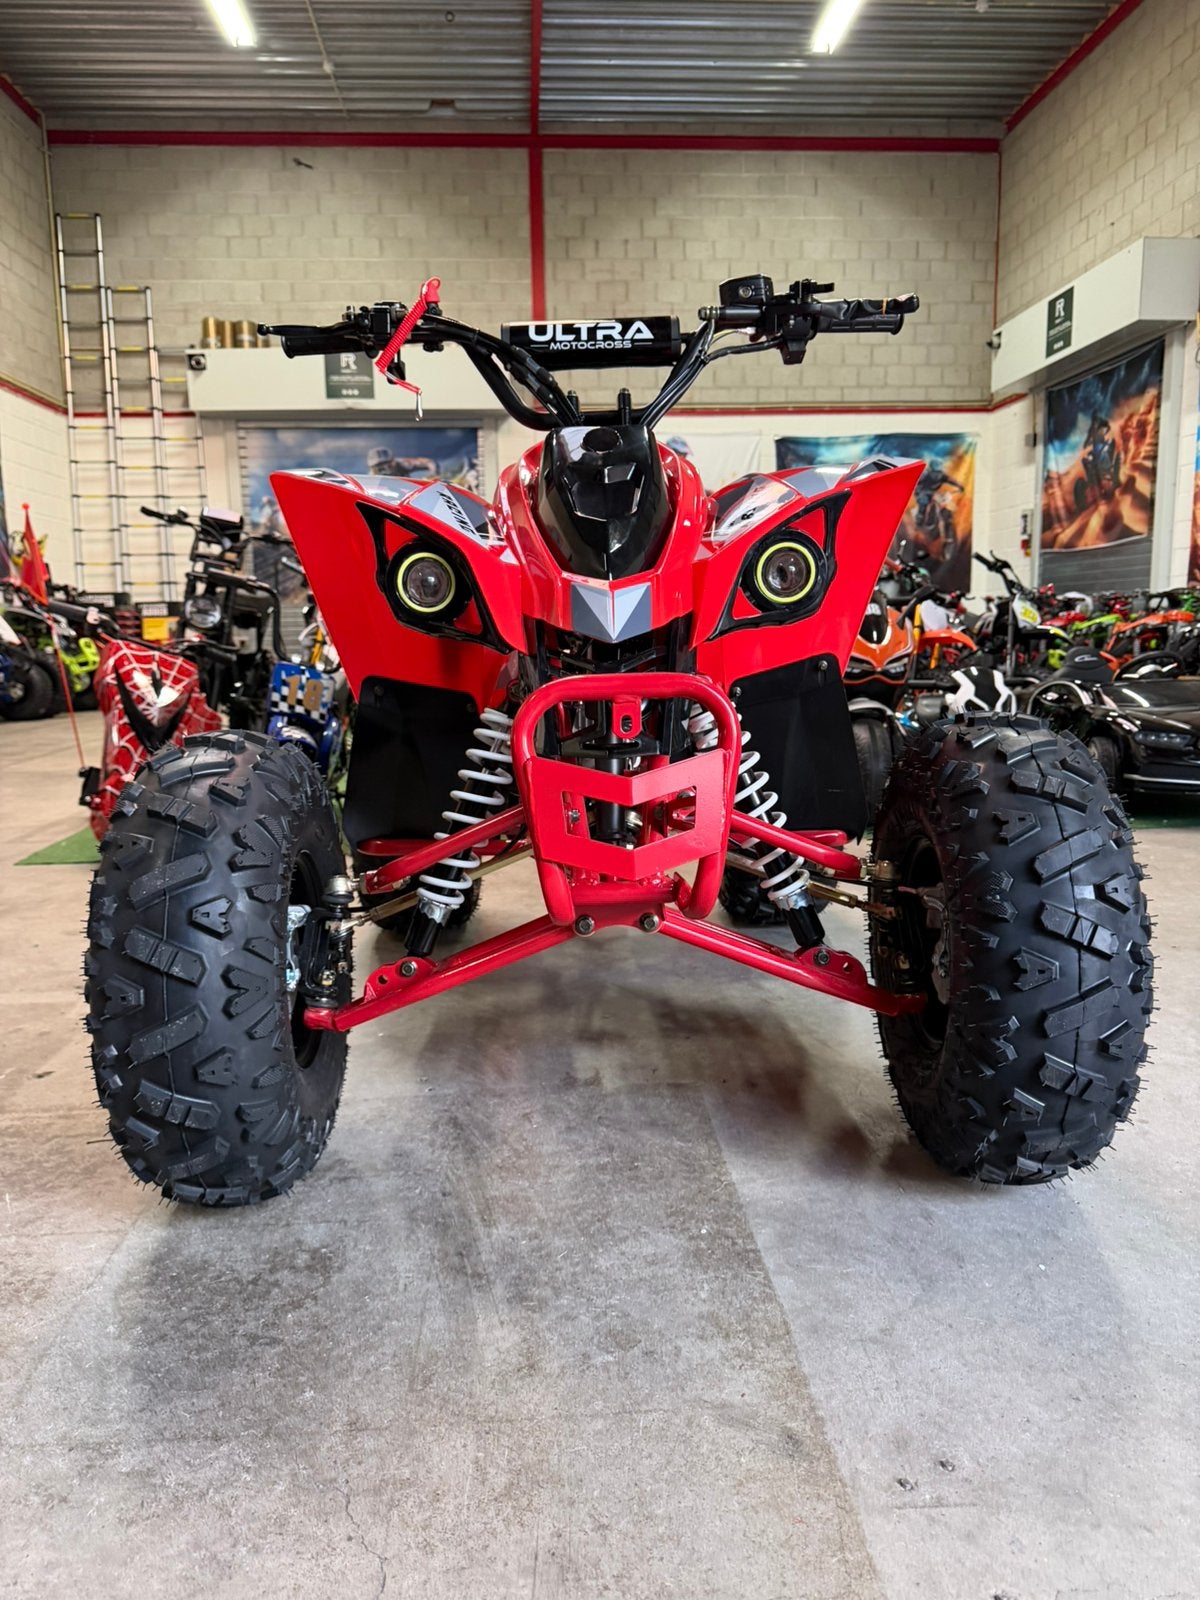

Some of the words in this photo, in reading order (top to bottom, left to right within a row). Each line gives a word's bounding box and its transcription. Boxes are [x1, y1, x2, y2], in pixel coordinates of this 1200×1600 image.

[1055, 298, 1065, 317] R
[528, 320, 655, 342] ULTRA
[550, 340, 632, 350] MOTOCROSS
[340, 352, 357, 370] R
[285, 674, 324, 712] 18
